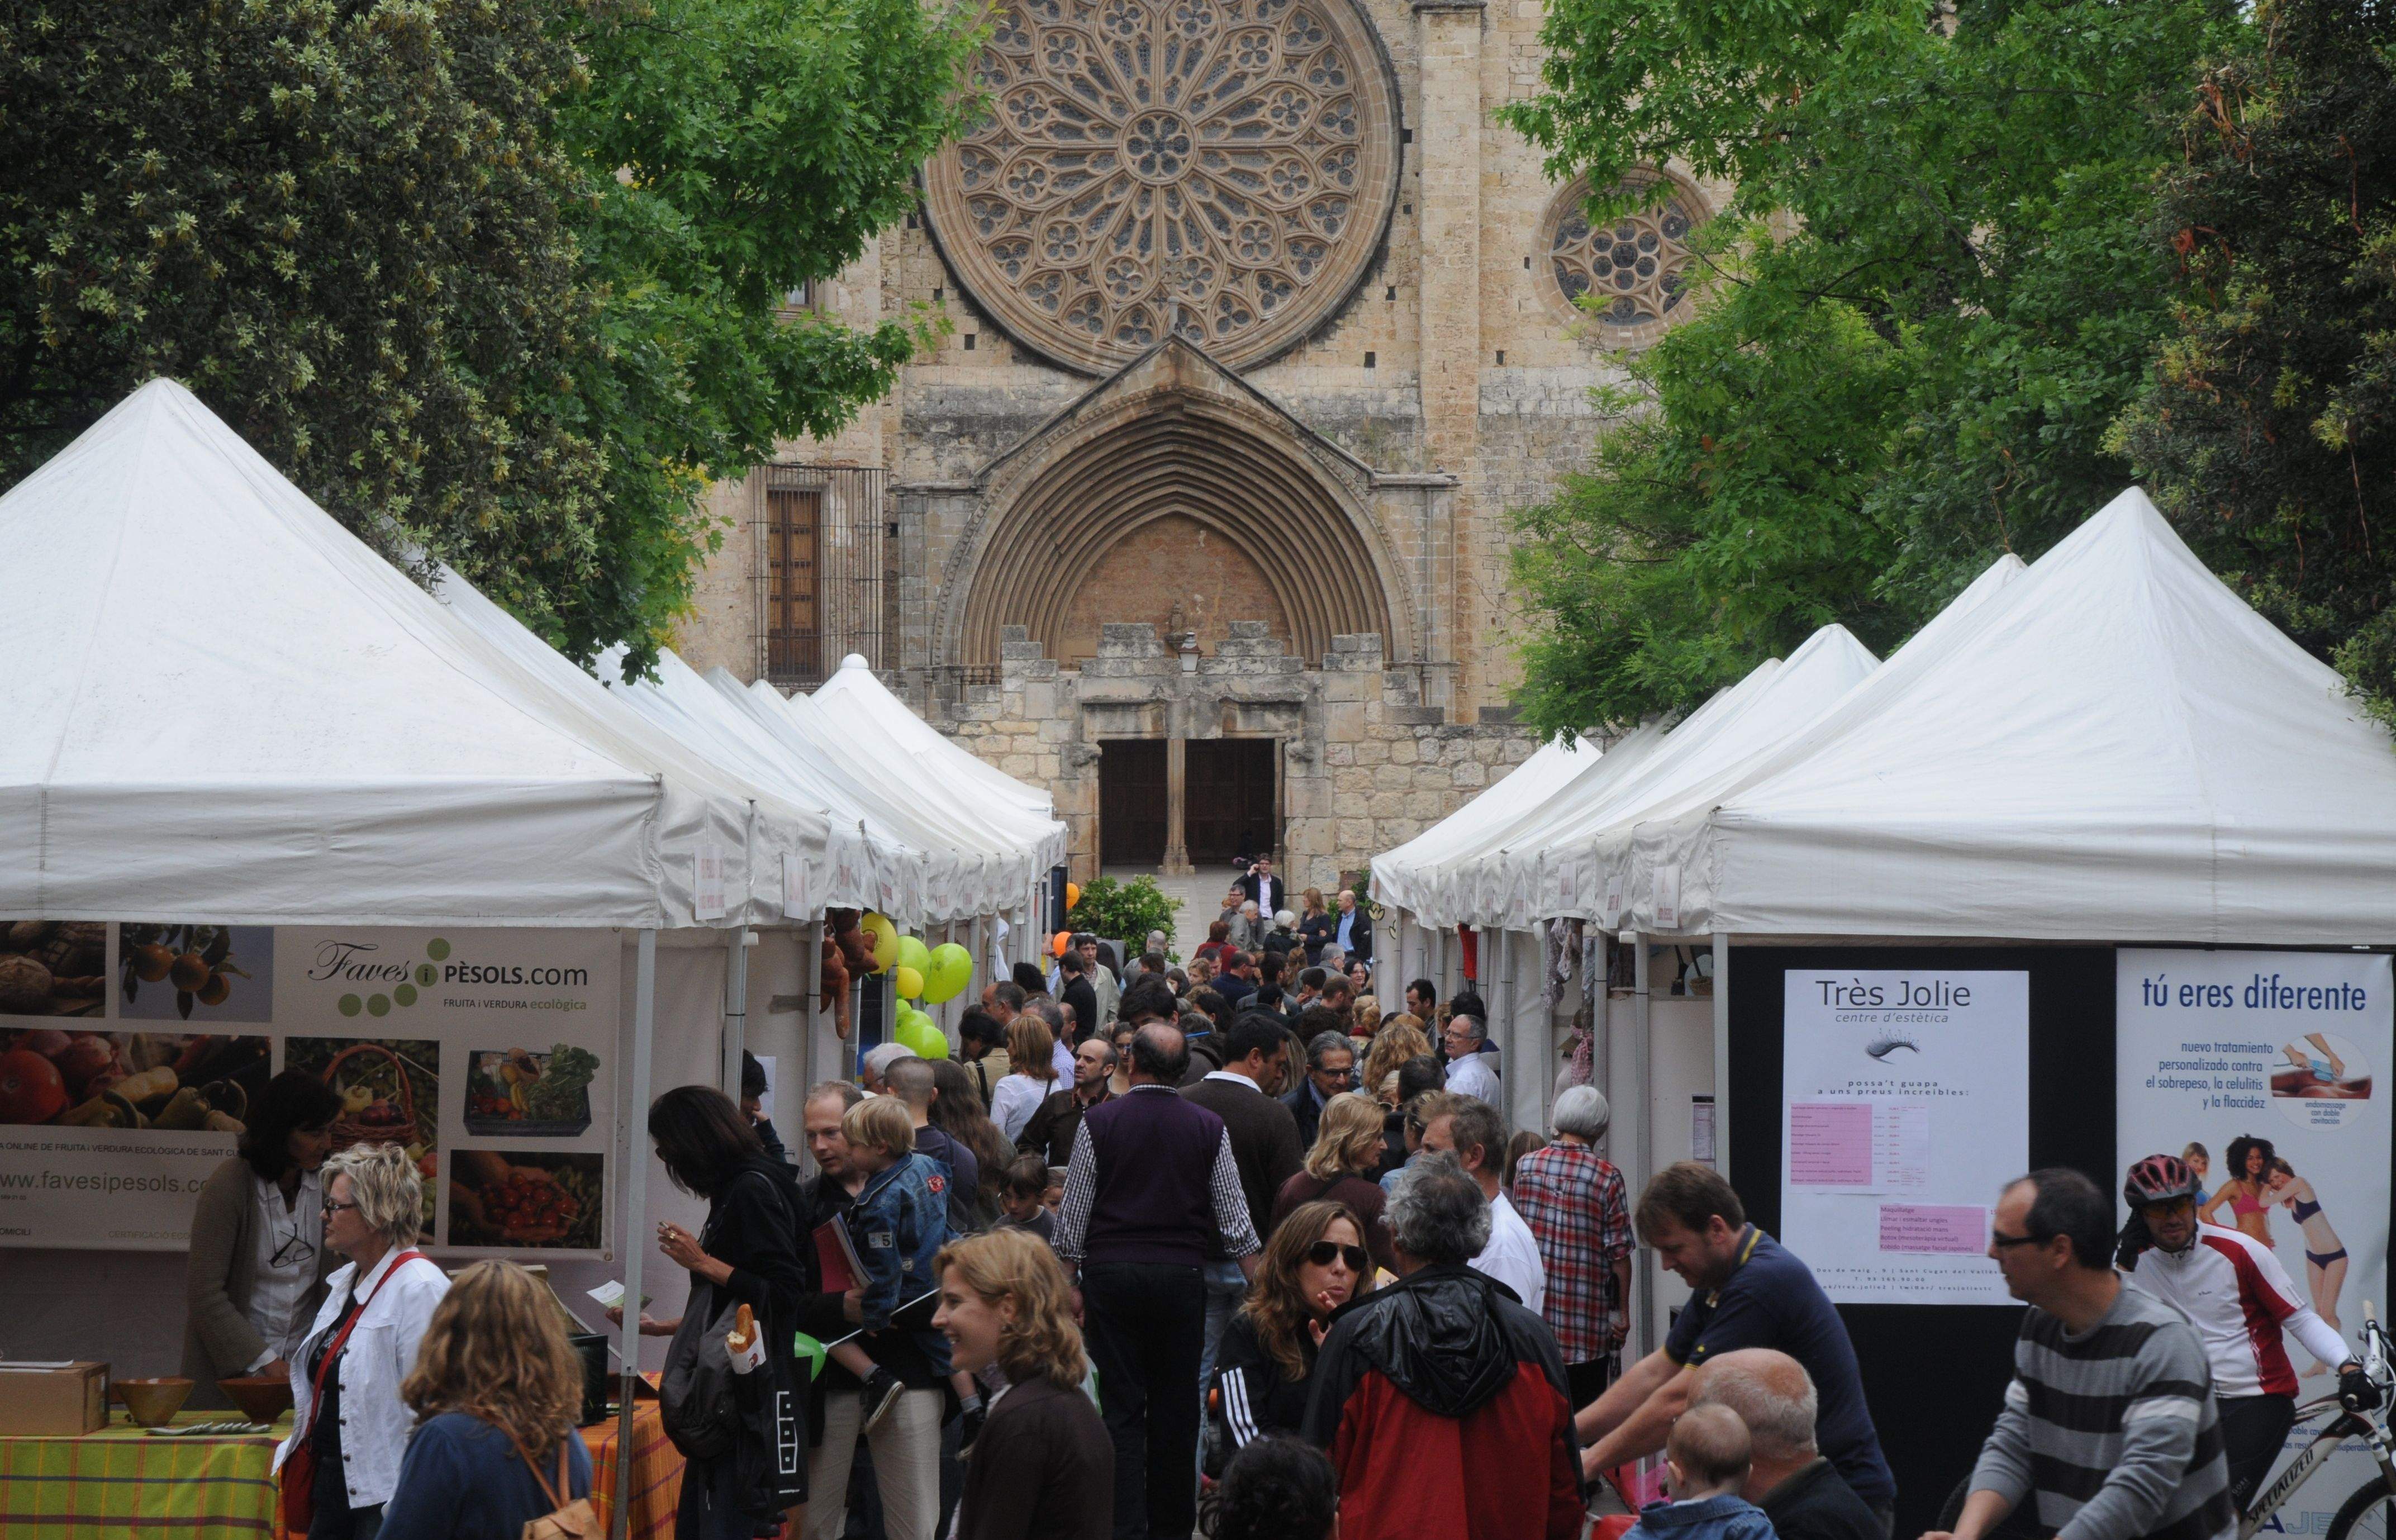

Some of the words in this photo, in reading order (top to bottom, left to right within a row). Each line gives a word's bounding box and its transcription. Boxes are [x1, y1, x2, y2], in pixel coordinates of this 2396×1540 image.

[308, 940, 410, 982] Faves
[424, 968, 429, 982] i
[444, 961, 588, 986] PÈSOLS.com
[1815, 978, 1884, 1006] Très
[1897, 980, 1971, 1007] Jolie
[2142, 974, 2169, 1006] tú
[2179, 983, 2234, 1008] eres
[2243, 973, 2366, 1011] diferente
[444, 999, 476, 1008] FRUITA
[478, 999, 481, 1008] i
[483, 1000, 528, 1009] VERDURA
[530, 999, 587, 1012] ecològica
[1835, 1013, 1877, 1023] centre
[1882, 1012, 1948, 1023] d'estètica
[2181, 1043, 2212, 1053] nuevo
[2214, 1042, 2273, 1054] tratamiento
[2159, 1058, 2228, 1072] personalizado
[2231, 1061, 2262, 1072] contra
[1848, 1080, 1894, 1088] possa't
[2146, 1075, 2155, 1088] el
[2157, 1075, 2210, 1091] sobrepeso,
[2214, 1076, 2223, 1089] la
[2226, 1076, 2263, 1090] celulitis
[2203, 1098, 2209, 1110] y
[2211, 1095, 2221, 1108] la
[2223, 1095, 2265, 1109] flaccidez
[6, 1143, 38, 1151] ONLINE
[55, 1143, 86, 1152] FRUITA
[92, 1144, 134, 1154] VERDURA
[135, 1146, 186, 1156] ECOLÒGICA
[187, 1148, 198, 1156] DE
[201, 1148, 224, 1157] SANT
[882, 1234, 891, 1247] 5
